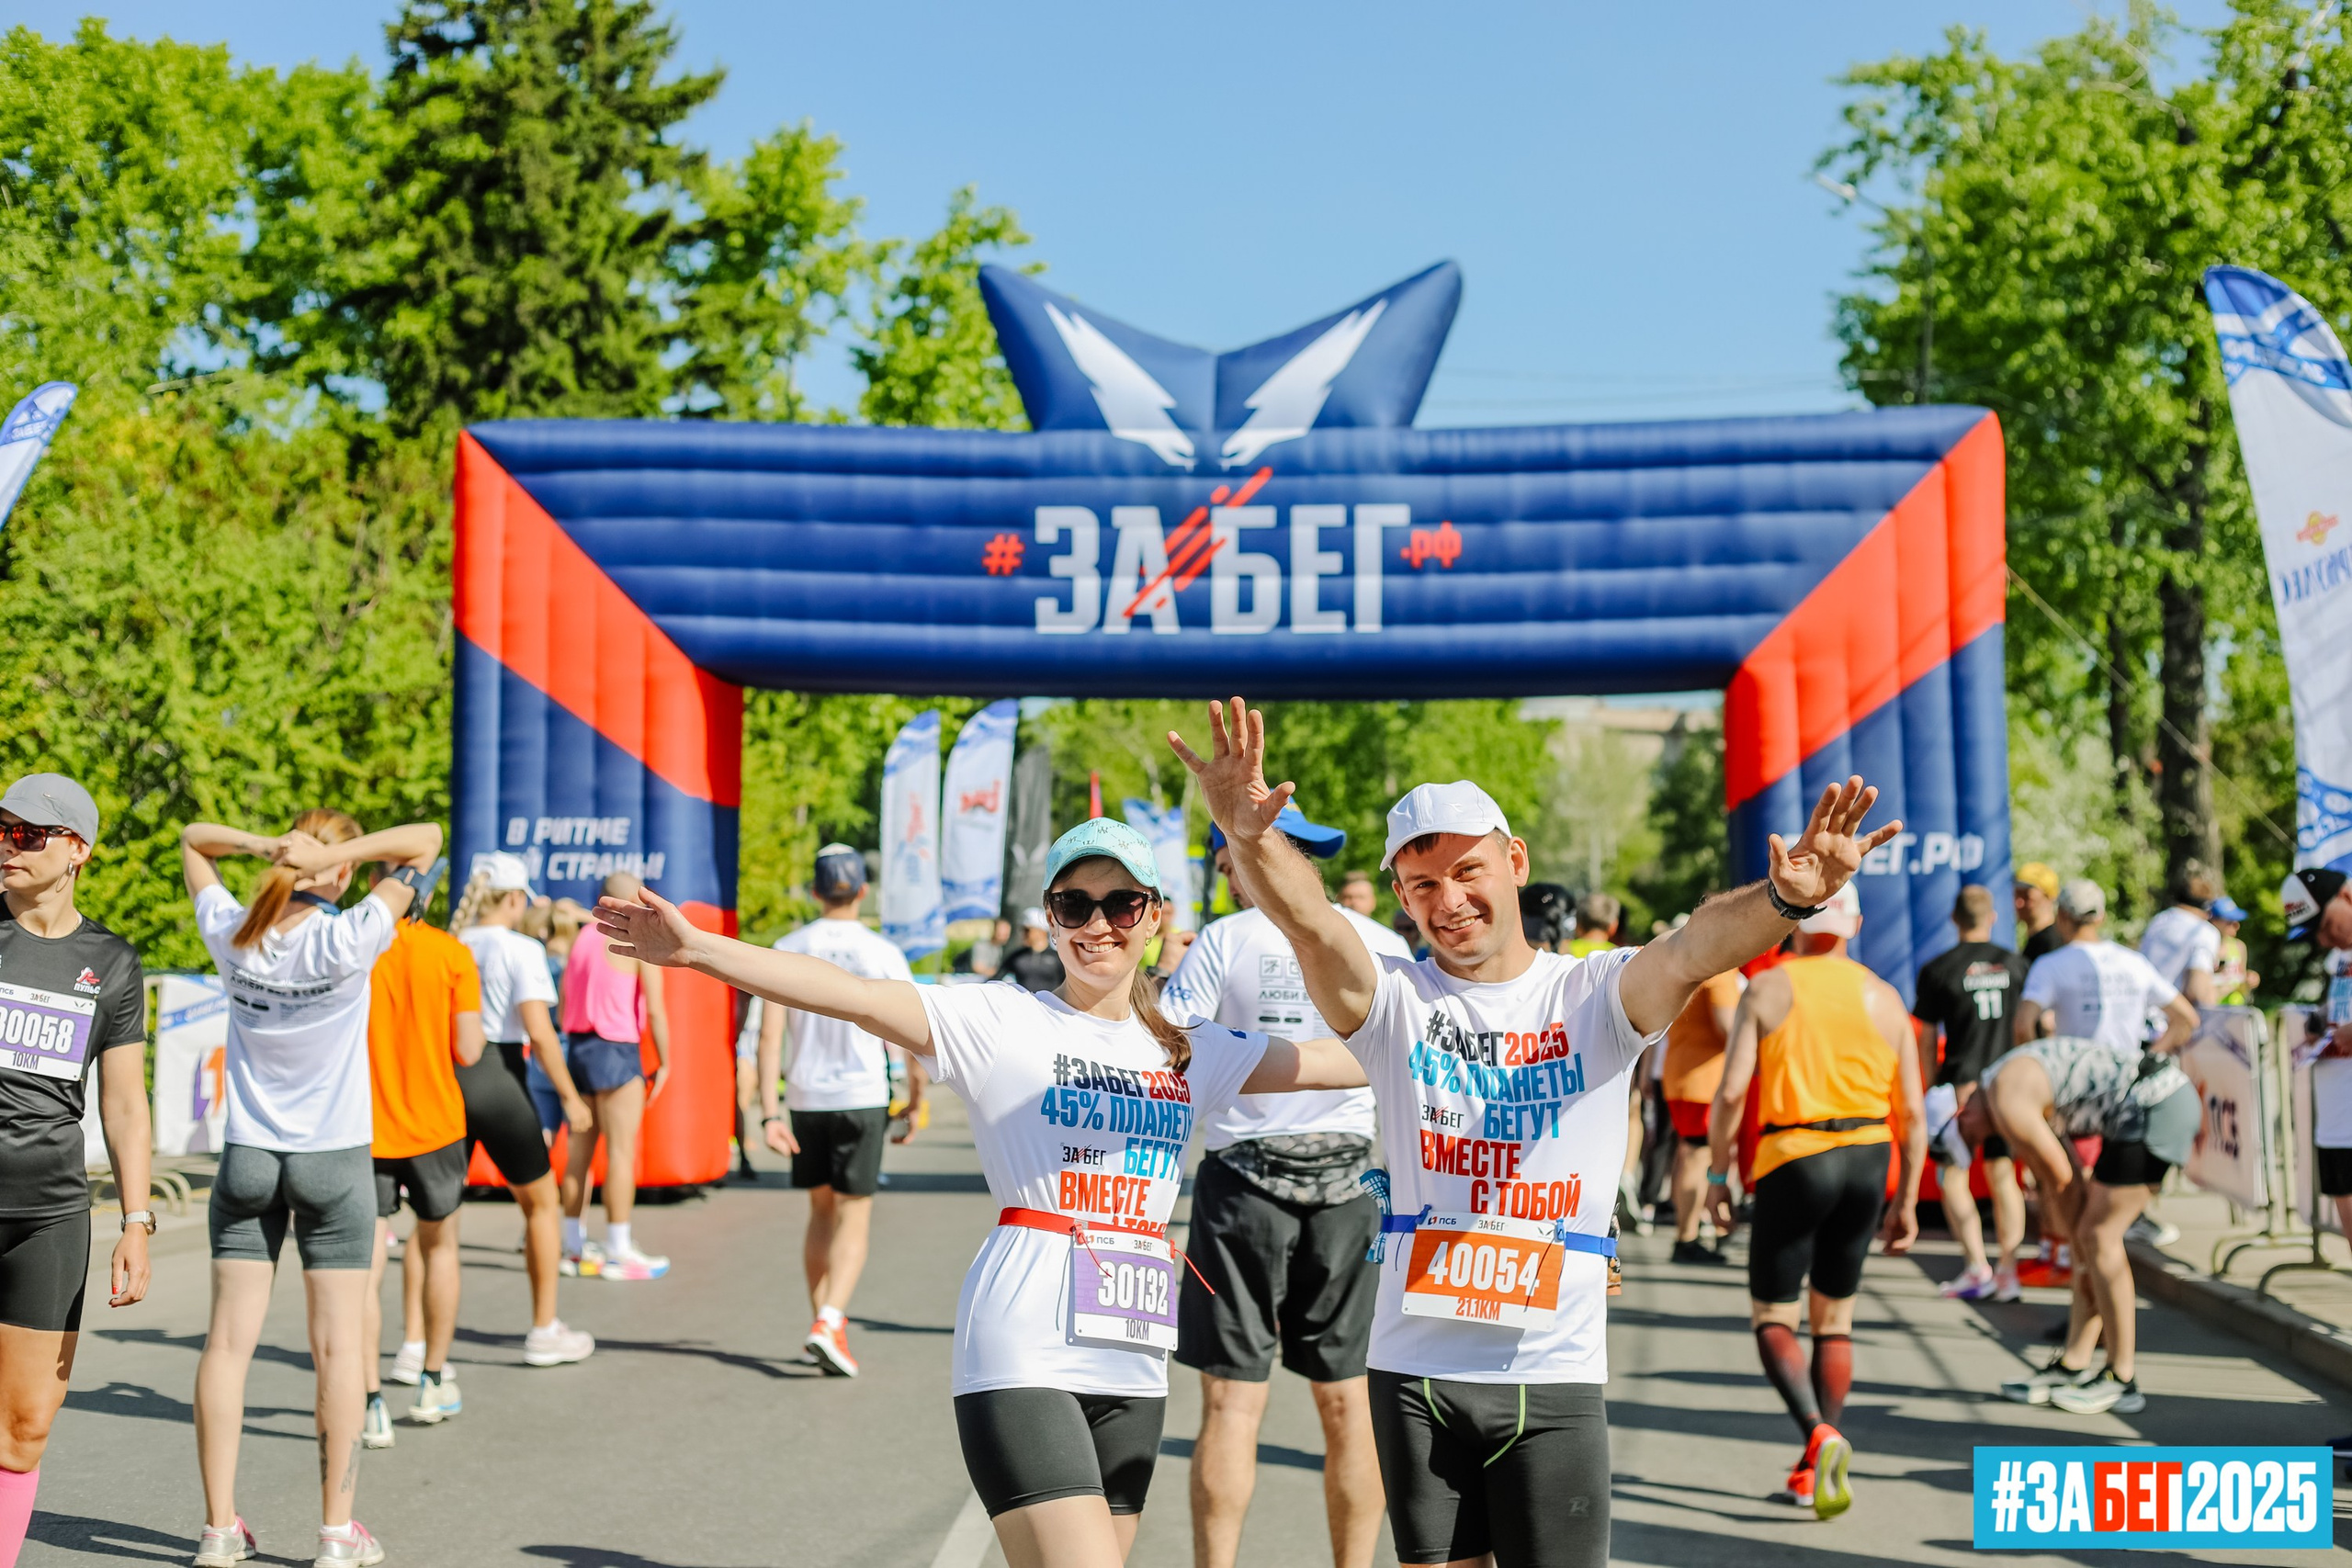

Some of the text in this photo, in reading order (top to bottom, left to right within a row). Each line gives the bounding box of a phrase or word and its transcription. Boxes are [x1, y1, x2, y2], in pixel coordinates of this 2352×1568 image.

[74, 982, 101, 995] ПУЛЬС
[1259, 989, 1299, 1001] ЛЮБИ
[1973, 989, 2003, 1021] 11
[1426, 1010, 1570, 1067] #ЗАБЕГ2025
[1053, 1053, 1192, 1104] #ЗАБЕГ2025
[1408, 1040, 1586, 1103] 45% ПЛАНЕТЫ
[1040, 1086, 1103, 1131] 45%
[1483, 1100, 1562, 1141] БЕГУТ
[1124, 1136, 1183, 1181] БЕГУТ
[1419, 1129, 1521, 1179] ВМЕСТЕ
[1059, 1170, 1151, 1217] ВМЕСТЕ
[1471, 1173, 1581, 1221] С ТОБОЙ
[1097, 1236, 1114, 1245] ПСБ
[1438, 1217, 1457, 1225] ПСБ
[1098, 1260, 1170, 1316] 30132
[1427, 1241, 1541, 1297] 40054
